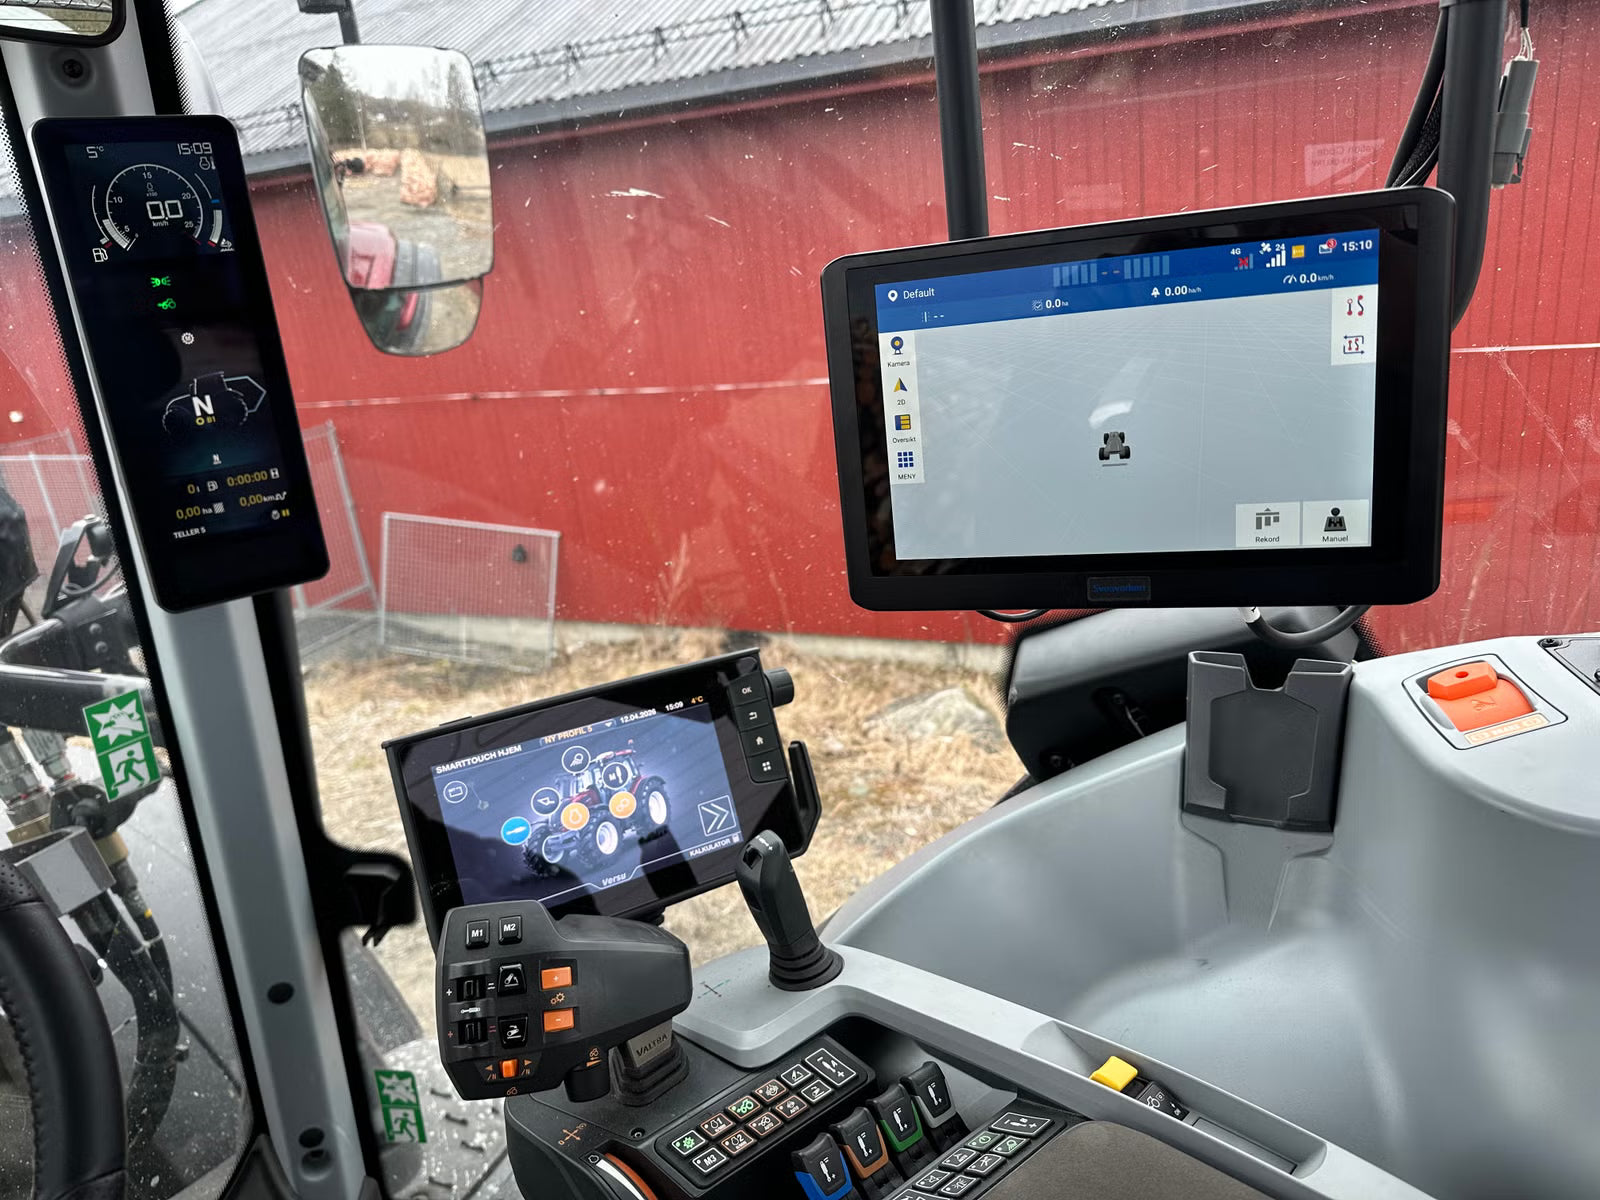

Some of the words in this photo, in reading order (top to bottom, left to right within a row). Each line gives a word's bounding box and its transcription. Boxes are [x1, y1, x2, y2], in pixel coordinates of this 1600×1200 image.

[177, 142, 213, 155] 15:09
[142, 172, 153, 180] 15
[113, 196, 123, 204] 10
[181, 192, 191, 200] 20
[146, 200, 184, 221] 0.0
[184, 221, 194, 229] 25
[1342, 240, 1373, 252] 15:10
[1299, 273, 1318, 284] 0.0
[1317, 273, 1334, 282] km/h
[903, 288, 935, 299] Default
[1164, 286, 1188, 297] 0.00
[1188, 286, 1202, 294] ha/h
[1045, 299, 1062, 309] 0.0
[887, 360, 910, 368] Kamera
[192, 394, 214, 417] N
[892, 436, 917, 444] Oversikt
[227, 470, 268, 487] 0:00:00
[897, 473, 916, 481] MENY
[239, 494, 264, 508] 0,00
[263, 494, 275, 503] km
[176, 506, 201, 520] 0,00
[202, 507, 213, 515] ha
[173, 528, 200, 539] TELLER
[1255, 535, 1280, 543] Rekord
[1322, 534, 1349, 543] Manuel
[620, 708, 657, 724] 12.04.2026
[665, 701, 684, 712] 15:09
[544, 733, 557, 745] NY
[556, 727, 587, 742] PROFIL
[587, 725, 593, 733] 5
[435, 750, 497, 775] SMARTTOUCH
[497, 744, 523, 760] HJEM
[689, 837, 731, 857] KALKULATOR
[601, 872, 627, 887] Versu
[471, 928, 484, 937] M1
[503, 923, 517, 932] M2
[635, 1032, 668, 1057] VALTRA
[790, 1106, 800, 1114] AUTO
[716, 1117, 724, 1126] 1
[763, 1123, 774, 1131] AUTO
[737, 1134, 745, 1143] 2
[703, 1154, 717, 1167] M3
